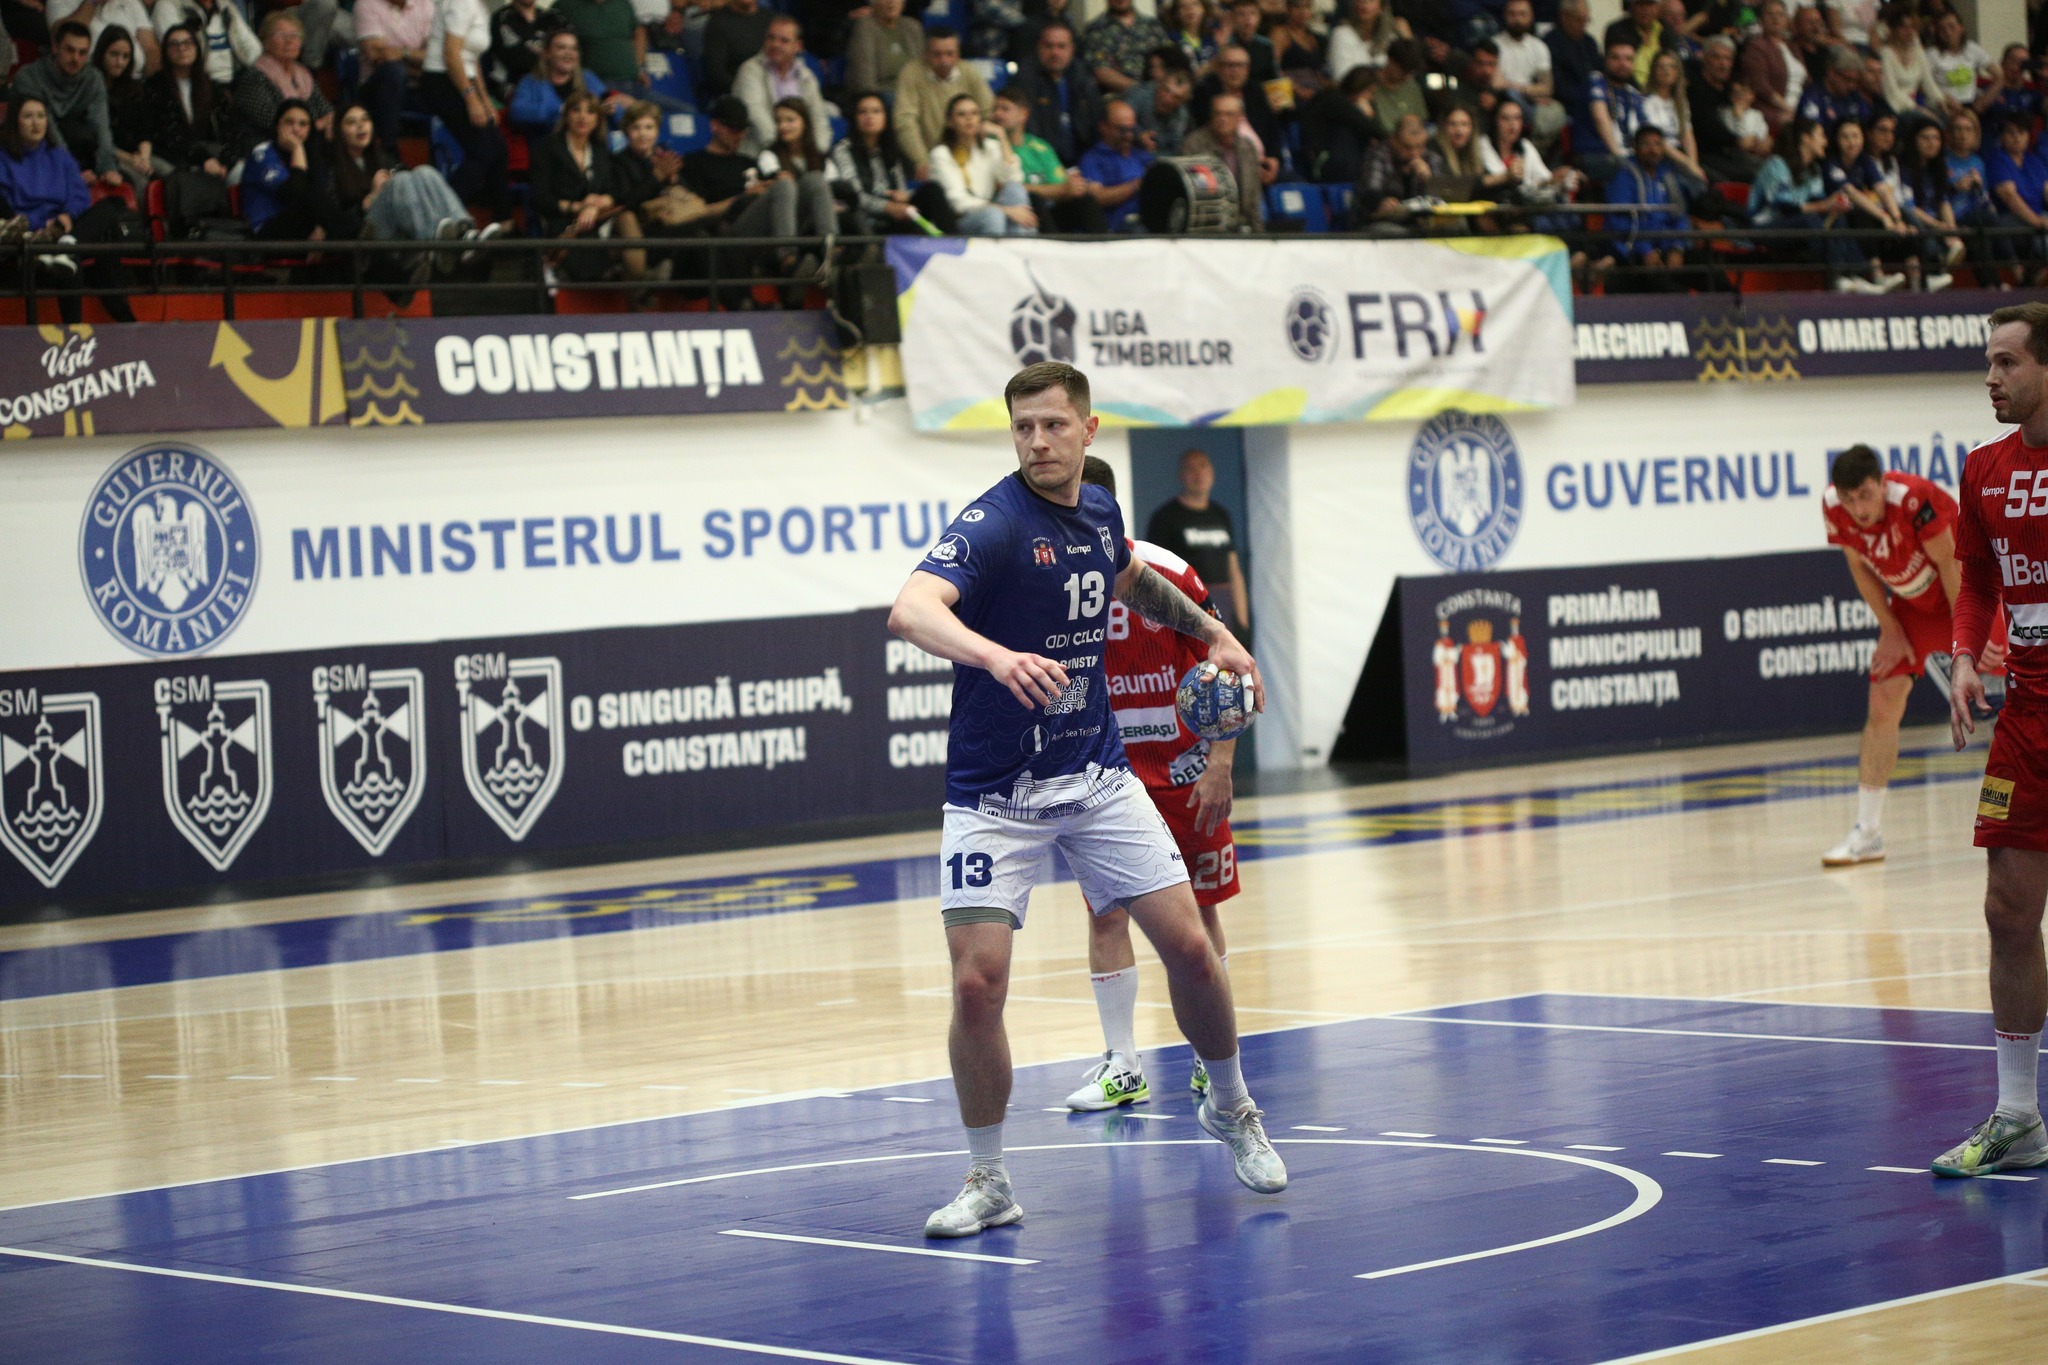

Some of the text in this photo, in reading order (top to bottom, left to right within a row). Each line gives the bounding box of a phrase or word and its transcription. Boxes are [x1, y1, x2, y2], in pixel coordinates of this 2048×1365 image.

[1090, 310, 1147, 336] LIGA
[1573, 321, 1690, 360] AECHIPA
[1799, 318, 1818, 354] O
[1818, 316, 1889, 352] MARE
[1888, 316, 1920, 350] DE
[40, 335, 97, 378] Visit
[434, 329, 765, 397] CONSTANȚA
[1091, 340, 1233, 367] ZIMBRILOR
[94, 452, 242, 528] GUVERNUL
[1546, 452, 1810, 512] GUVERNUL
[1981, 486, 2005, 497] Kempa
[2004, 470, 2048, 518] 55
[291, 513, 681, 581] MINISTERUL
[1066, 544, 1092, 555] Kempa
[94, 569, 249, 651] ROMÂNIEI
[1064, 570, 1106, 621] 13
[1548, 584, 1661, 628] PRIMĂRIA
[1724, 609, 1741, 641] O
[1742, 594, 1837, 640] SINGURĂ
[454, 652, 506, 682] CSM
[1549, 626, 1702, 669] MUNICIPIULUI
[154, 674, 211, 705] CSM
[312, 663, 367, 693] CSM
[570, 667, 852, 731] O SINGURĂ ECHIPĂ,
[1551, 669, 1681, 711] CONSTANȚA
[0, 688, 38, 717] SM
[622, 727, 806, 777] CONSTANȚA!
[946, 853, 994, 889] 13
[1193, 843, 1235, 890] 28
